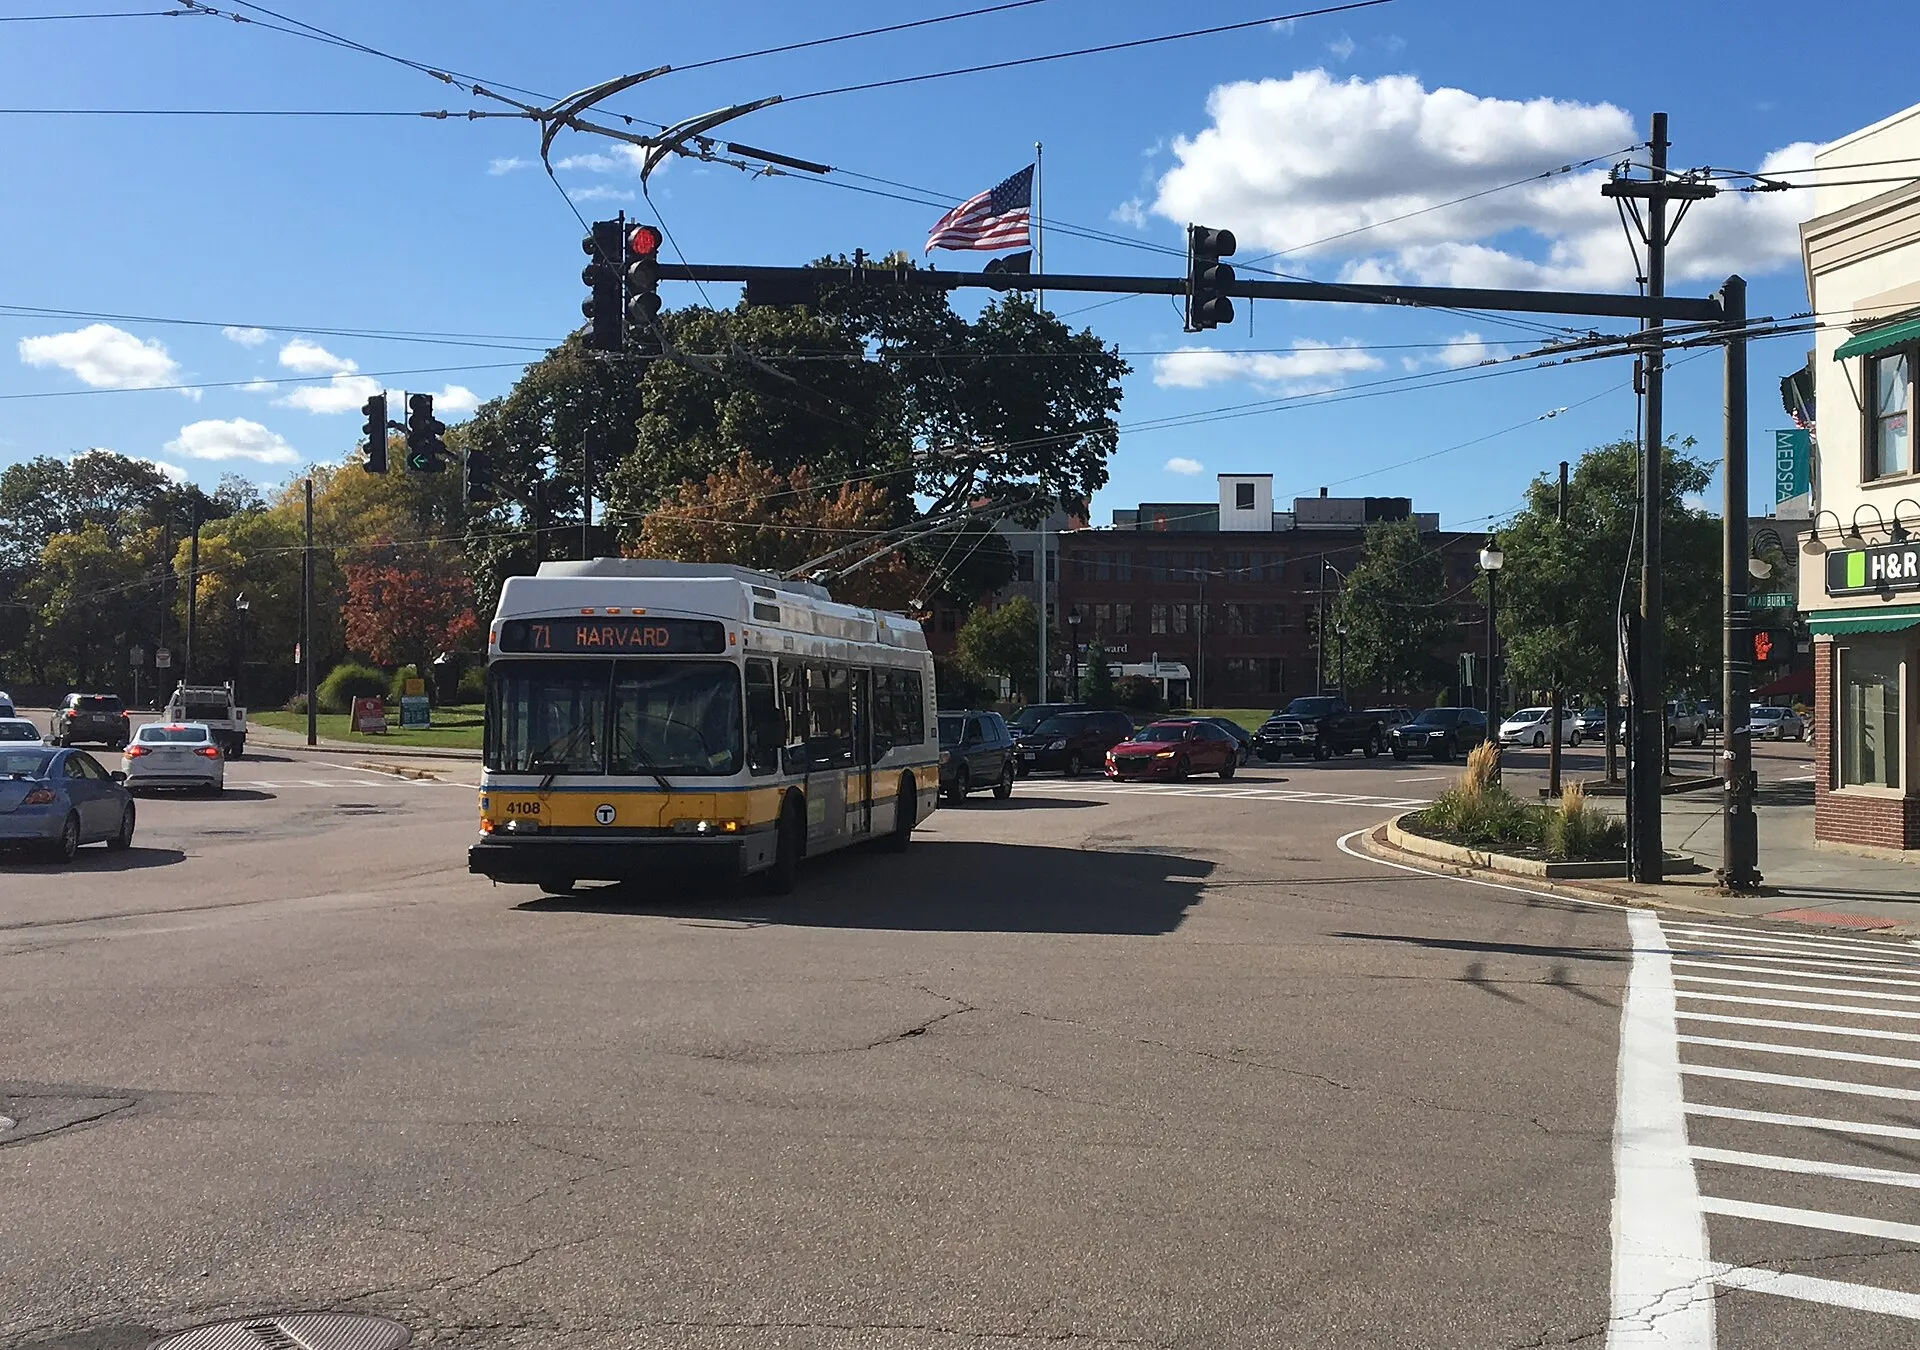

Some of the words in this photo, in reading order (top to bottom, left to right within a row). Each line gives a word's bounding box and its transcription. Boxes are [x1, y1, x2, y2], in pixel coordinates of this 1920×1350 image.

[1777, 432, 1794, 503] MEDSPA
[1872, 552, 1918, 580] H&R
[1757, 595, 1786, 607] AUBURN
[532, 625, 551, 648] 71
[576, 626, 670, 647] HARVARD
[506, 802, 541, 814] 4108
